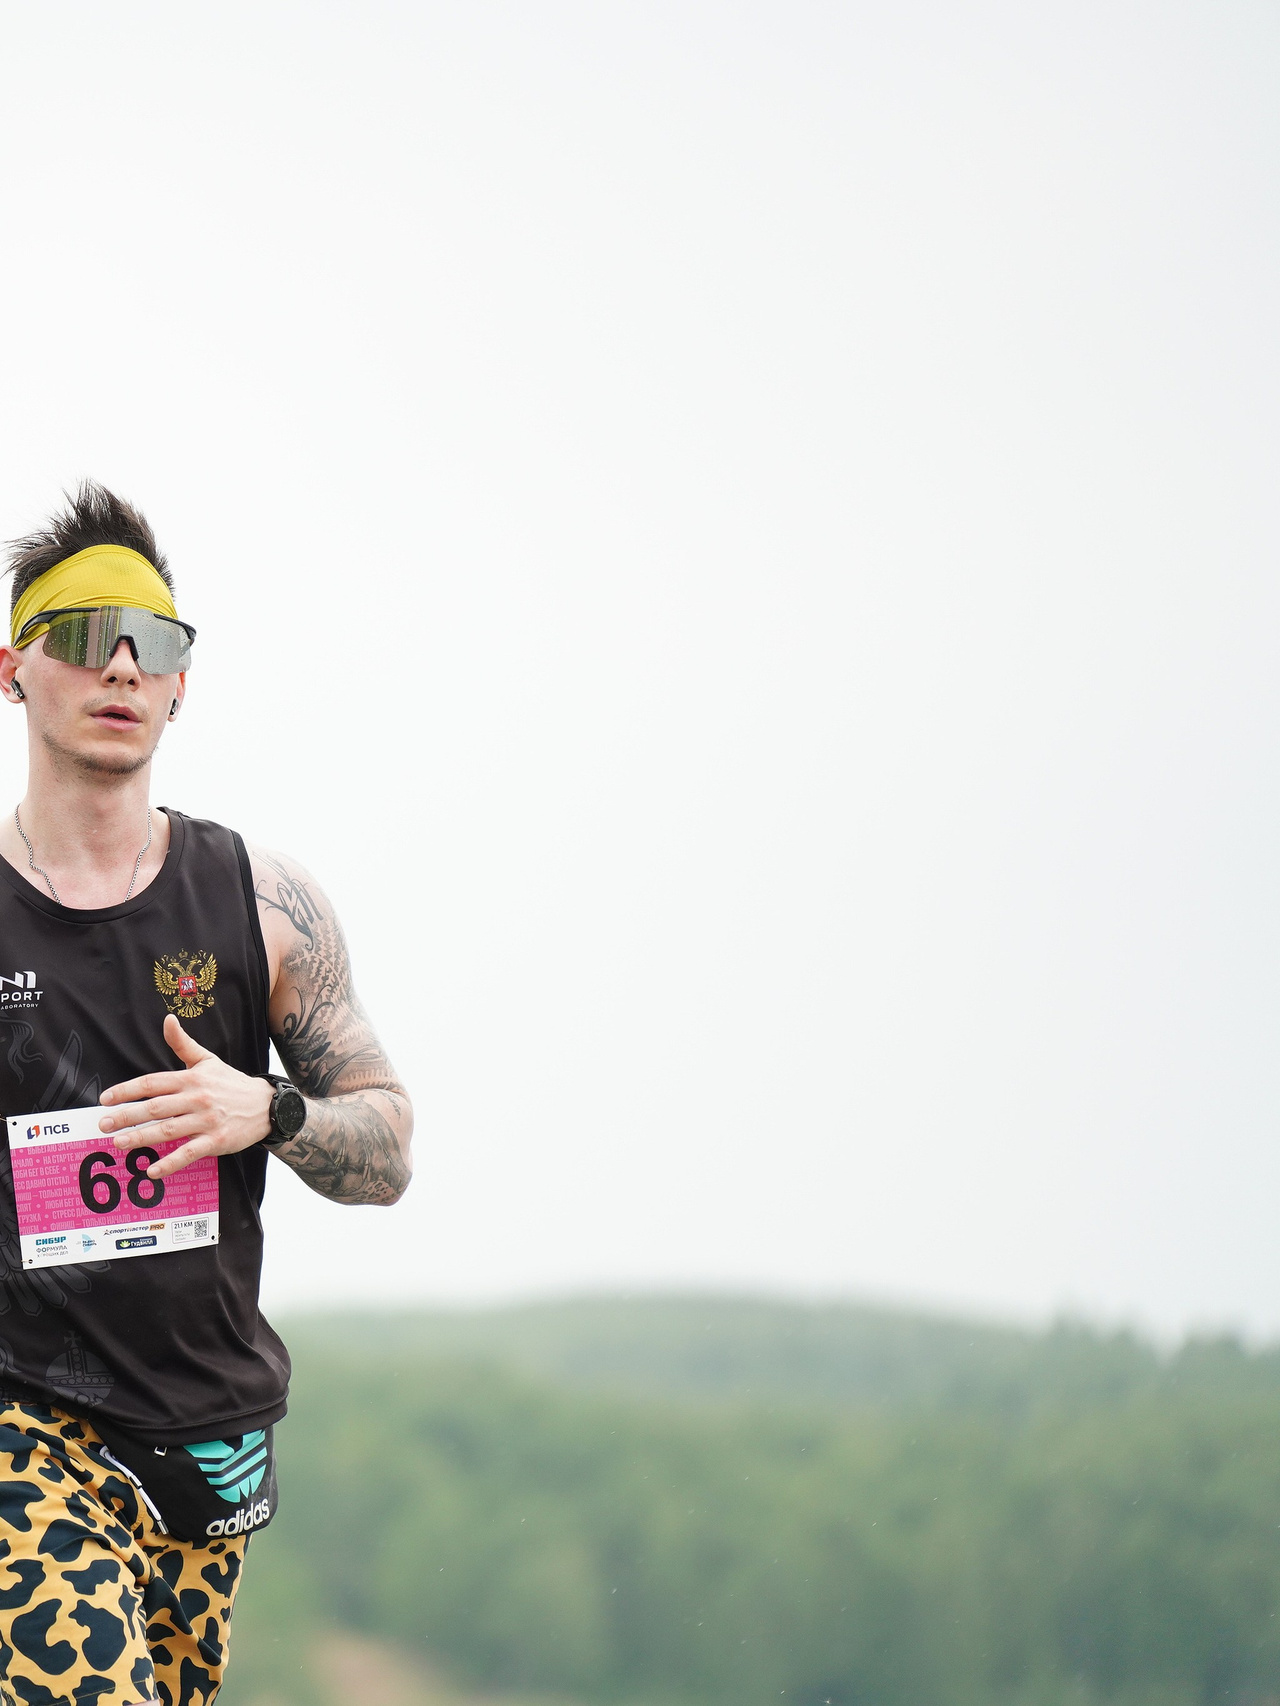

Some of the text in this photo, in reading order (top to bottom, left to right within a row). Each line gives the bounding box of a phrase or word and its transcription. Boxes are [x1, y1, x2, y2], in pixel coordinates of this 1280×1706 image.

[44, 1124, 70, 1135] ПСБ
[80, 1146, 165, 1214] 68
[35, 1236, 67, 1246] СИБУР
[36, 1245, 67, 1253] ФОРМУЛА
[206, 1498, 270, 1536] adidas
